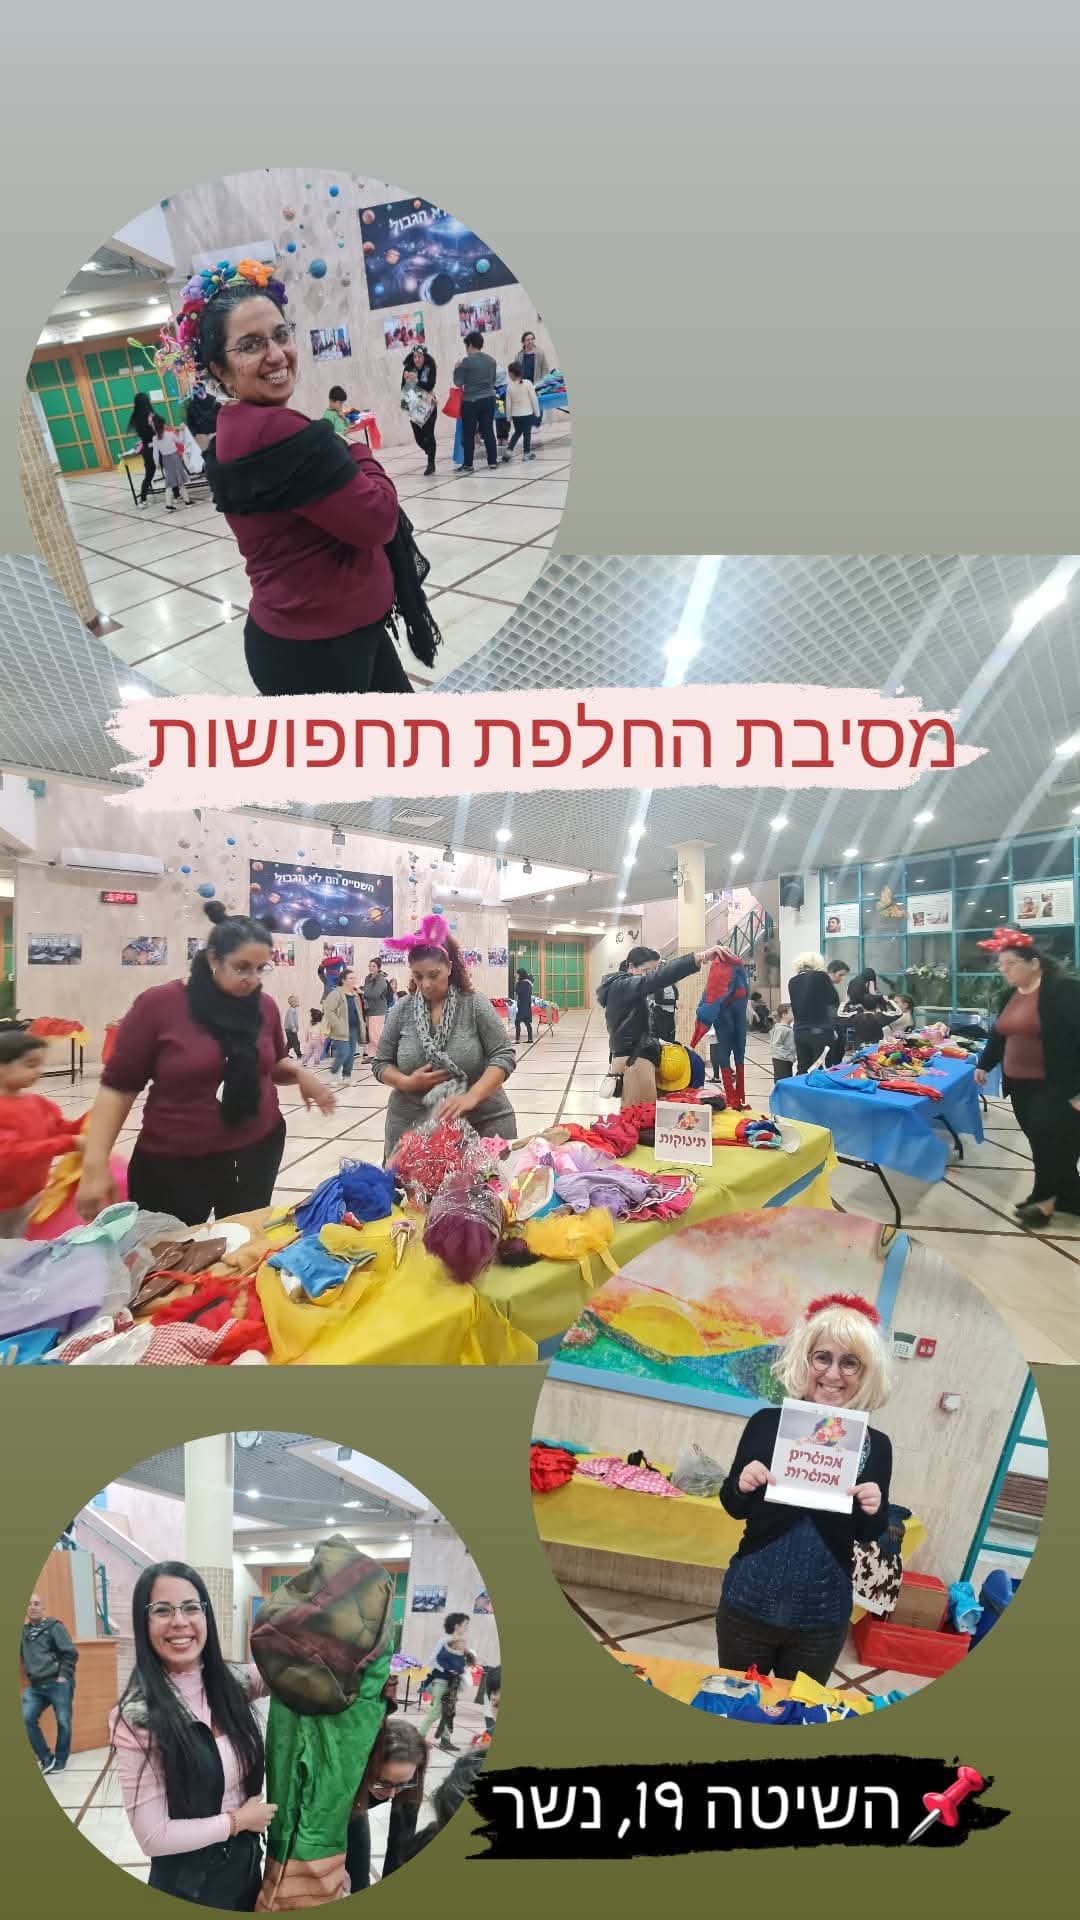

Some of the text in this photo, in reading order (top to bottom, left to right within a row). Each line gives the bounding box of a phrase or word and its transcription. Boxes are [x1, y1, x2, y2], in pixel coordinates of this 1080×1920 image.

[389, 210, 428, 235] הגבול
[274, 872, 375, 893] השמיים הם לא הגבול
[658, 1133, 707, 1149] תינוקות
[788, 1448, 844, 1469] מבוגרים
[784, 1465, 841, 1486] מבוגרות
